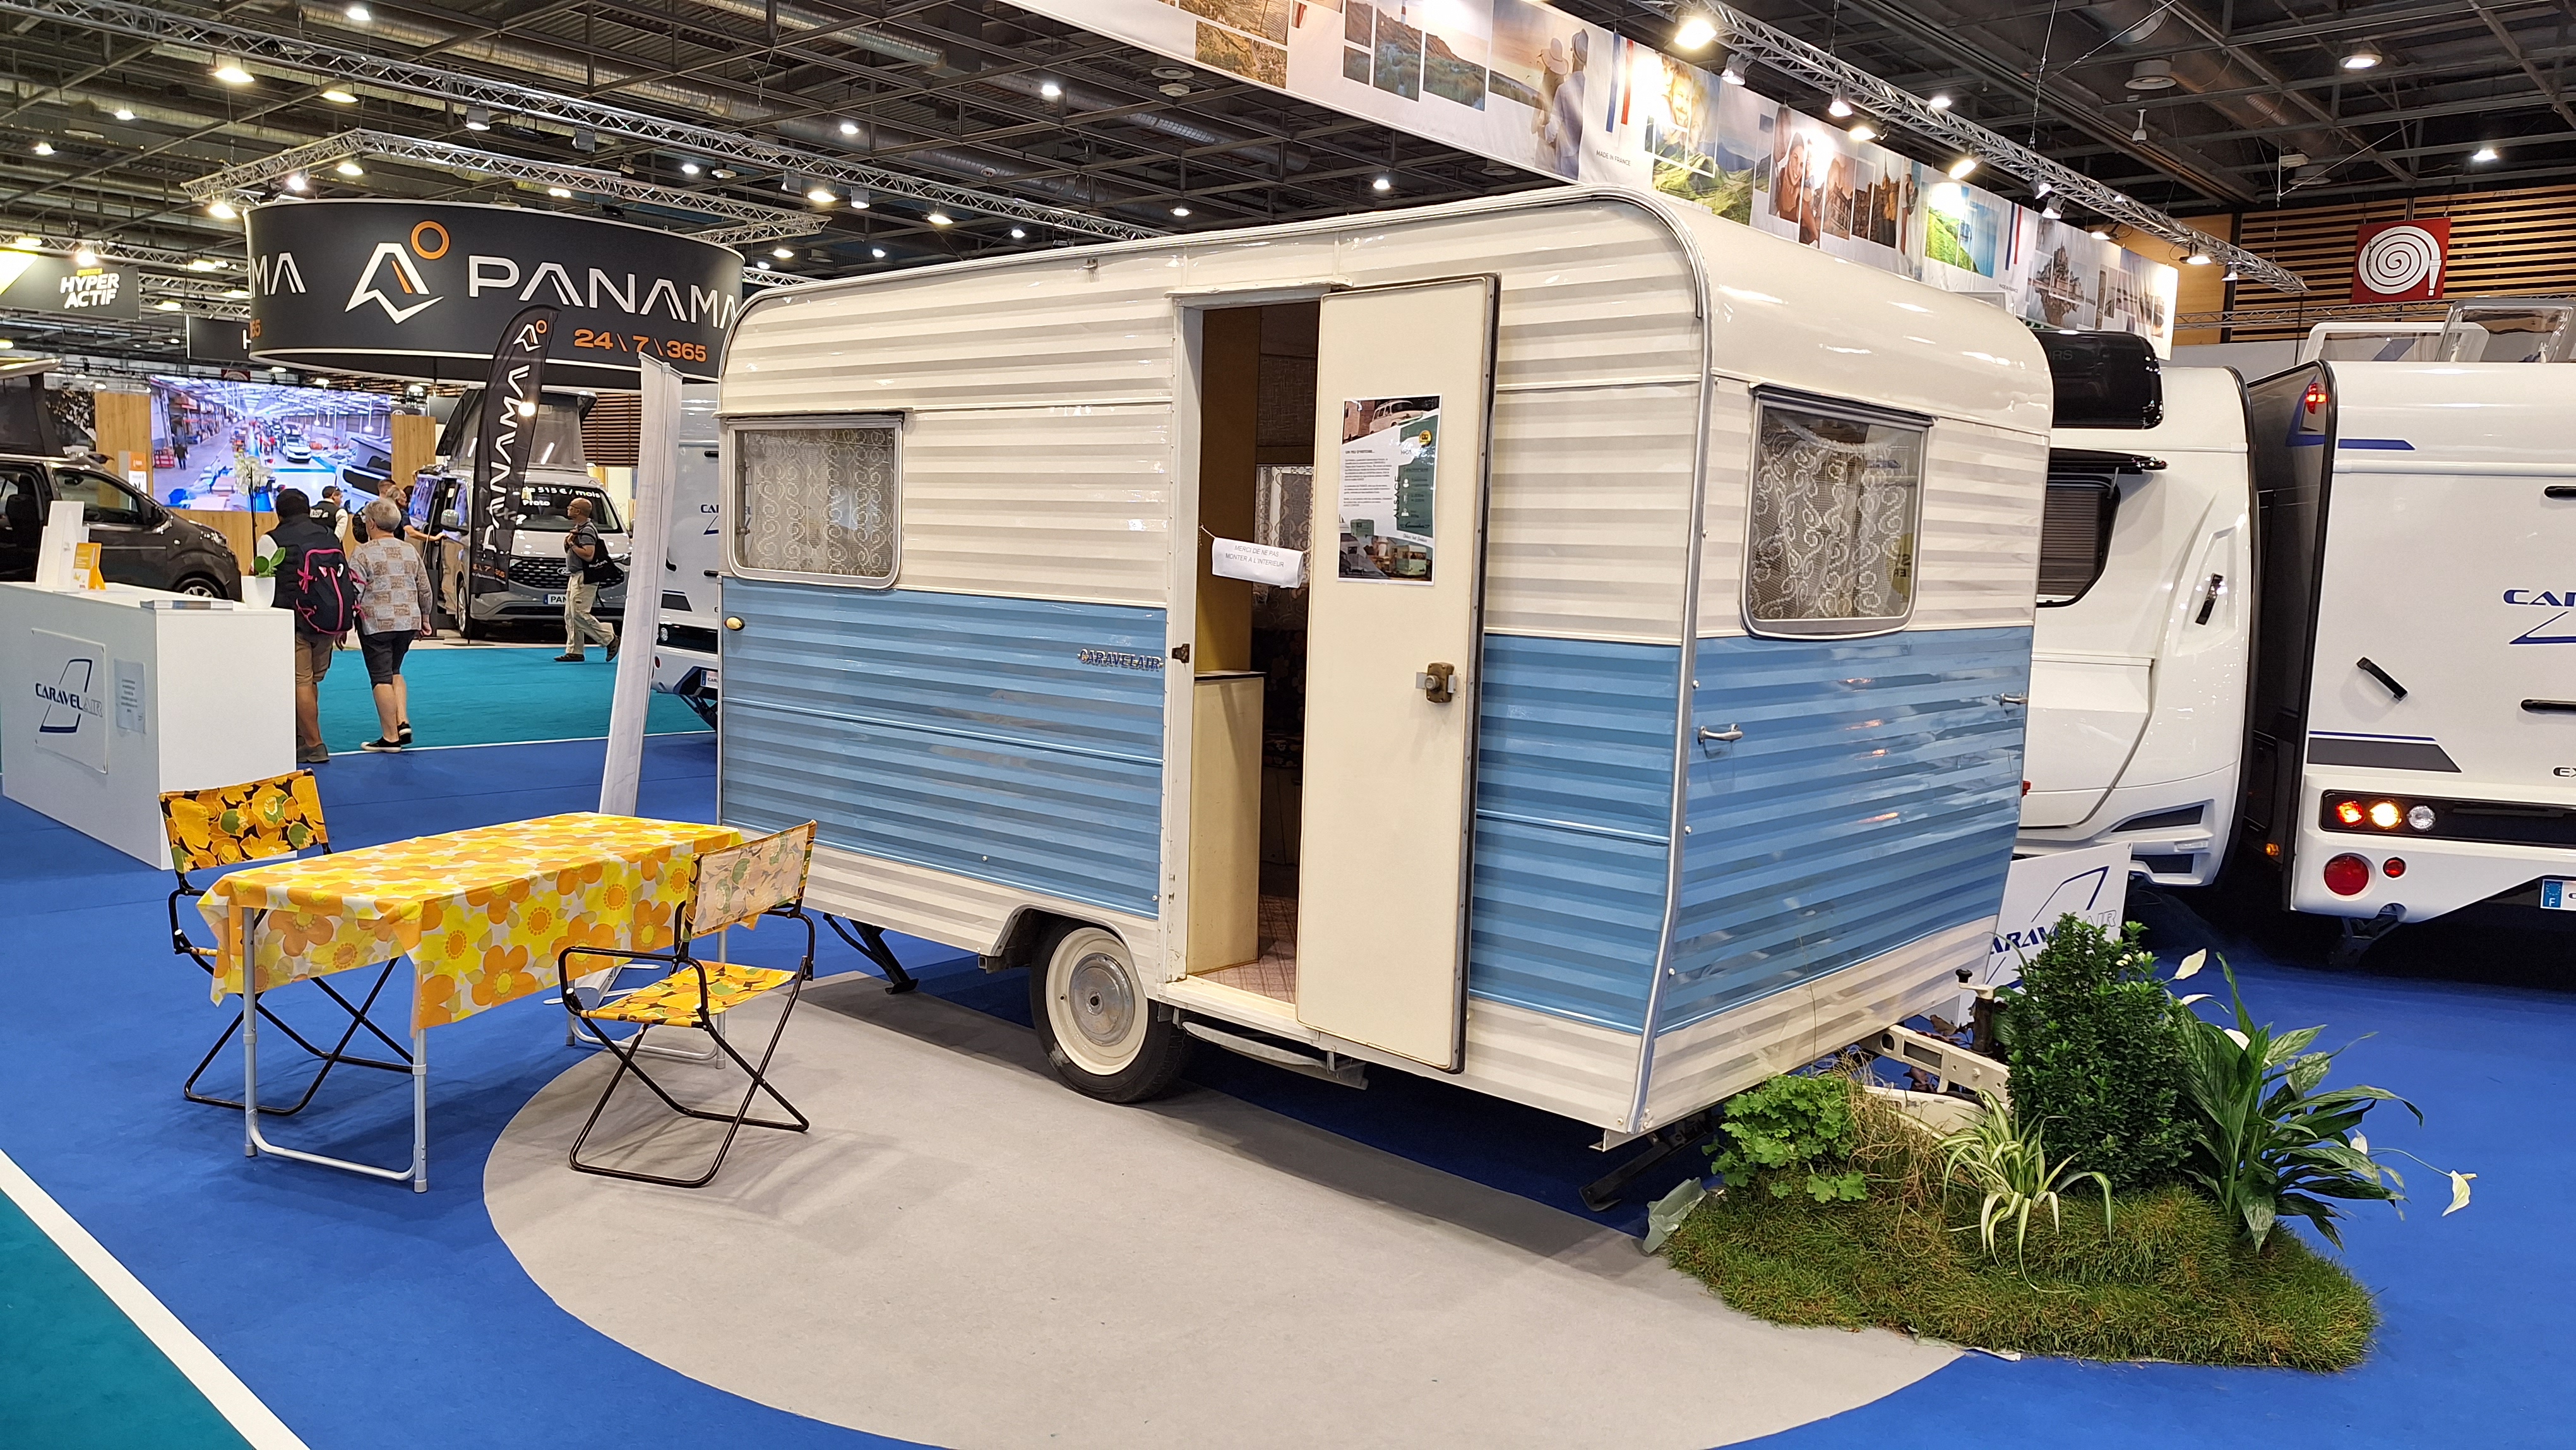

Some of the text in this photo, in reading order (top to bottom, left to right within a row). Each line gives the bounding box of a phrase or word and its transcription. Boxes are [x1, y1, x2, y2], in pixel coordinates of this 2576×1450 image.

[1596, 150, 1609, 159] MADE
[1614, 156, 1631, 166] FRANCE
[60, 273, 120, 294] HYPER
[468, 255, 737, 329] PANAMA
[64, 289, 117, 309] ACTIF
[666, 340, 707, 362] 365
[482, 364, 530, 553] PANAMA
[575, 490, 601, 498] mois
[1225, 553, 1248, 561] MONTER
[1253, 558, 1284, 567] L'INTERIEUR
[1079, 649, 1162, 672] CARAVELAIR
[35, 683, 103, 717] CARAVELAIR
[2549, 897, 2556, 907] F
